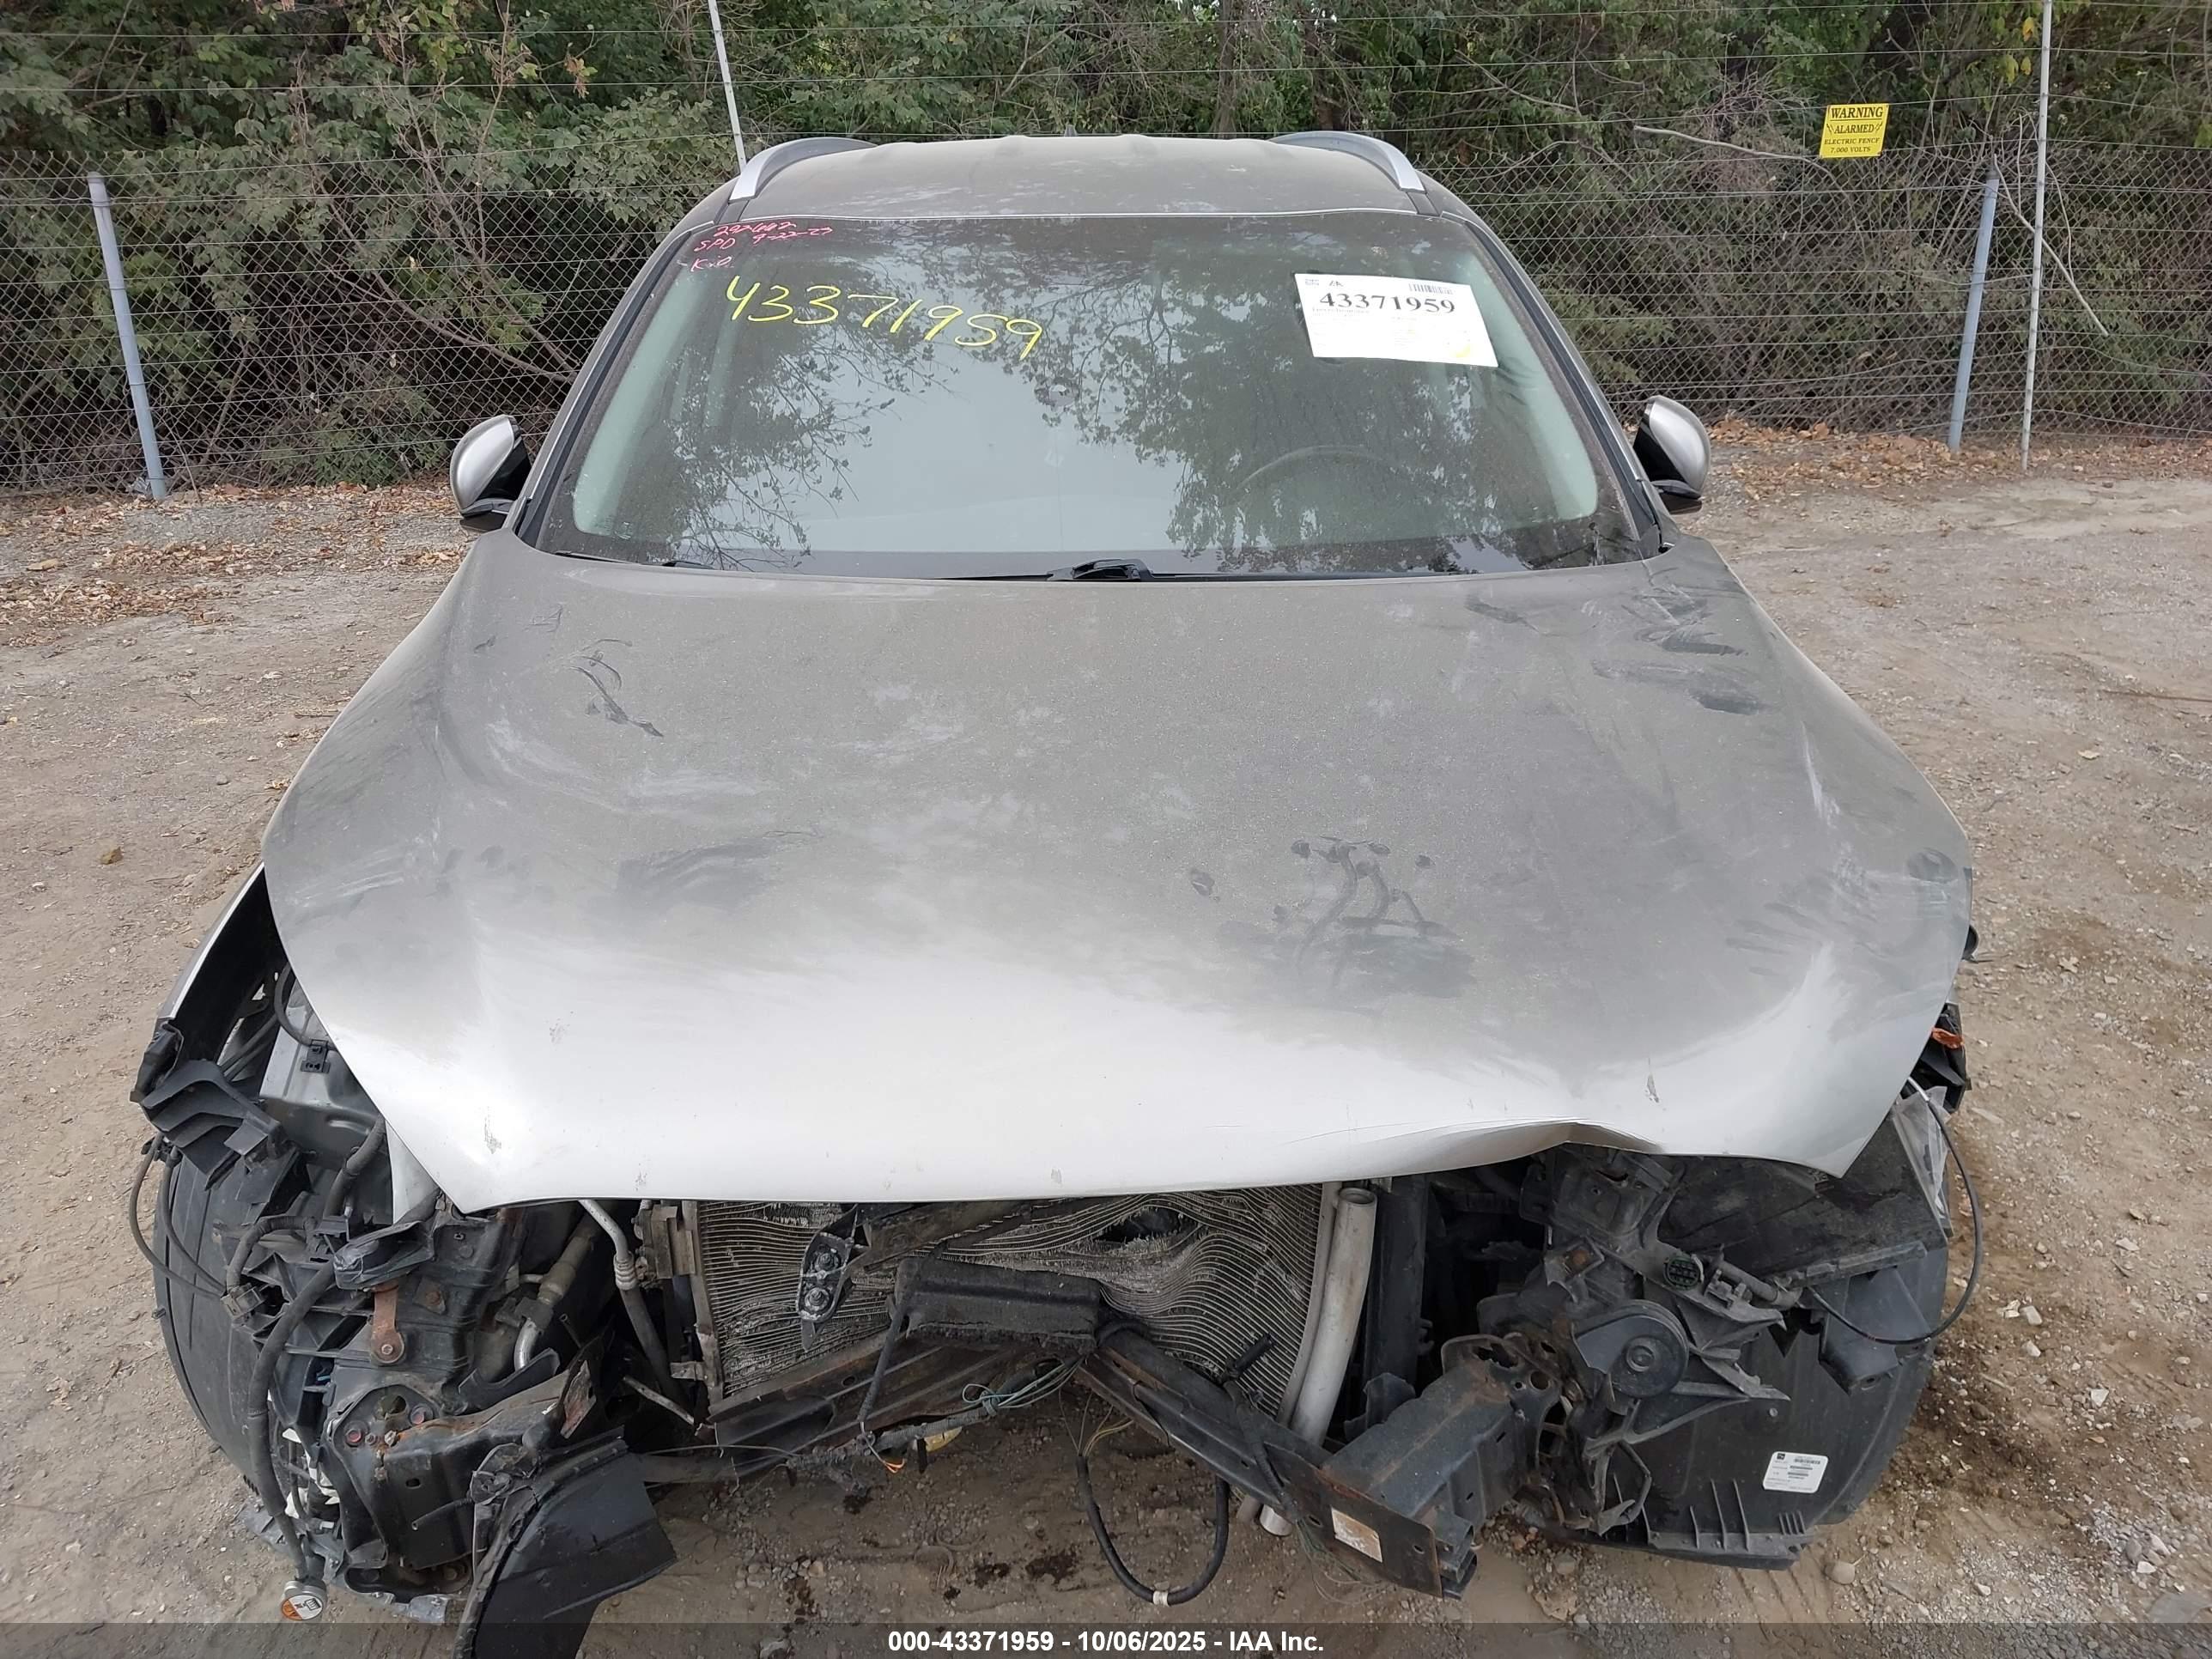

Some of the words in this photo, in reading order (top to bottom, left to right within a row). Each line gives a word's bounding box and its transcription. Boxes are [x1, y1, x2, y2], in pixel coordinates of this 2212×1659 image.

[1831, 106, 1883, 118] WARNING
[1834, 124, 1875, 134] ALARMED
[1319, 292, 1455, 314] 43371959
[725, 275, 1043, 360] 43371959
